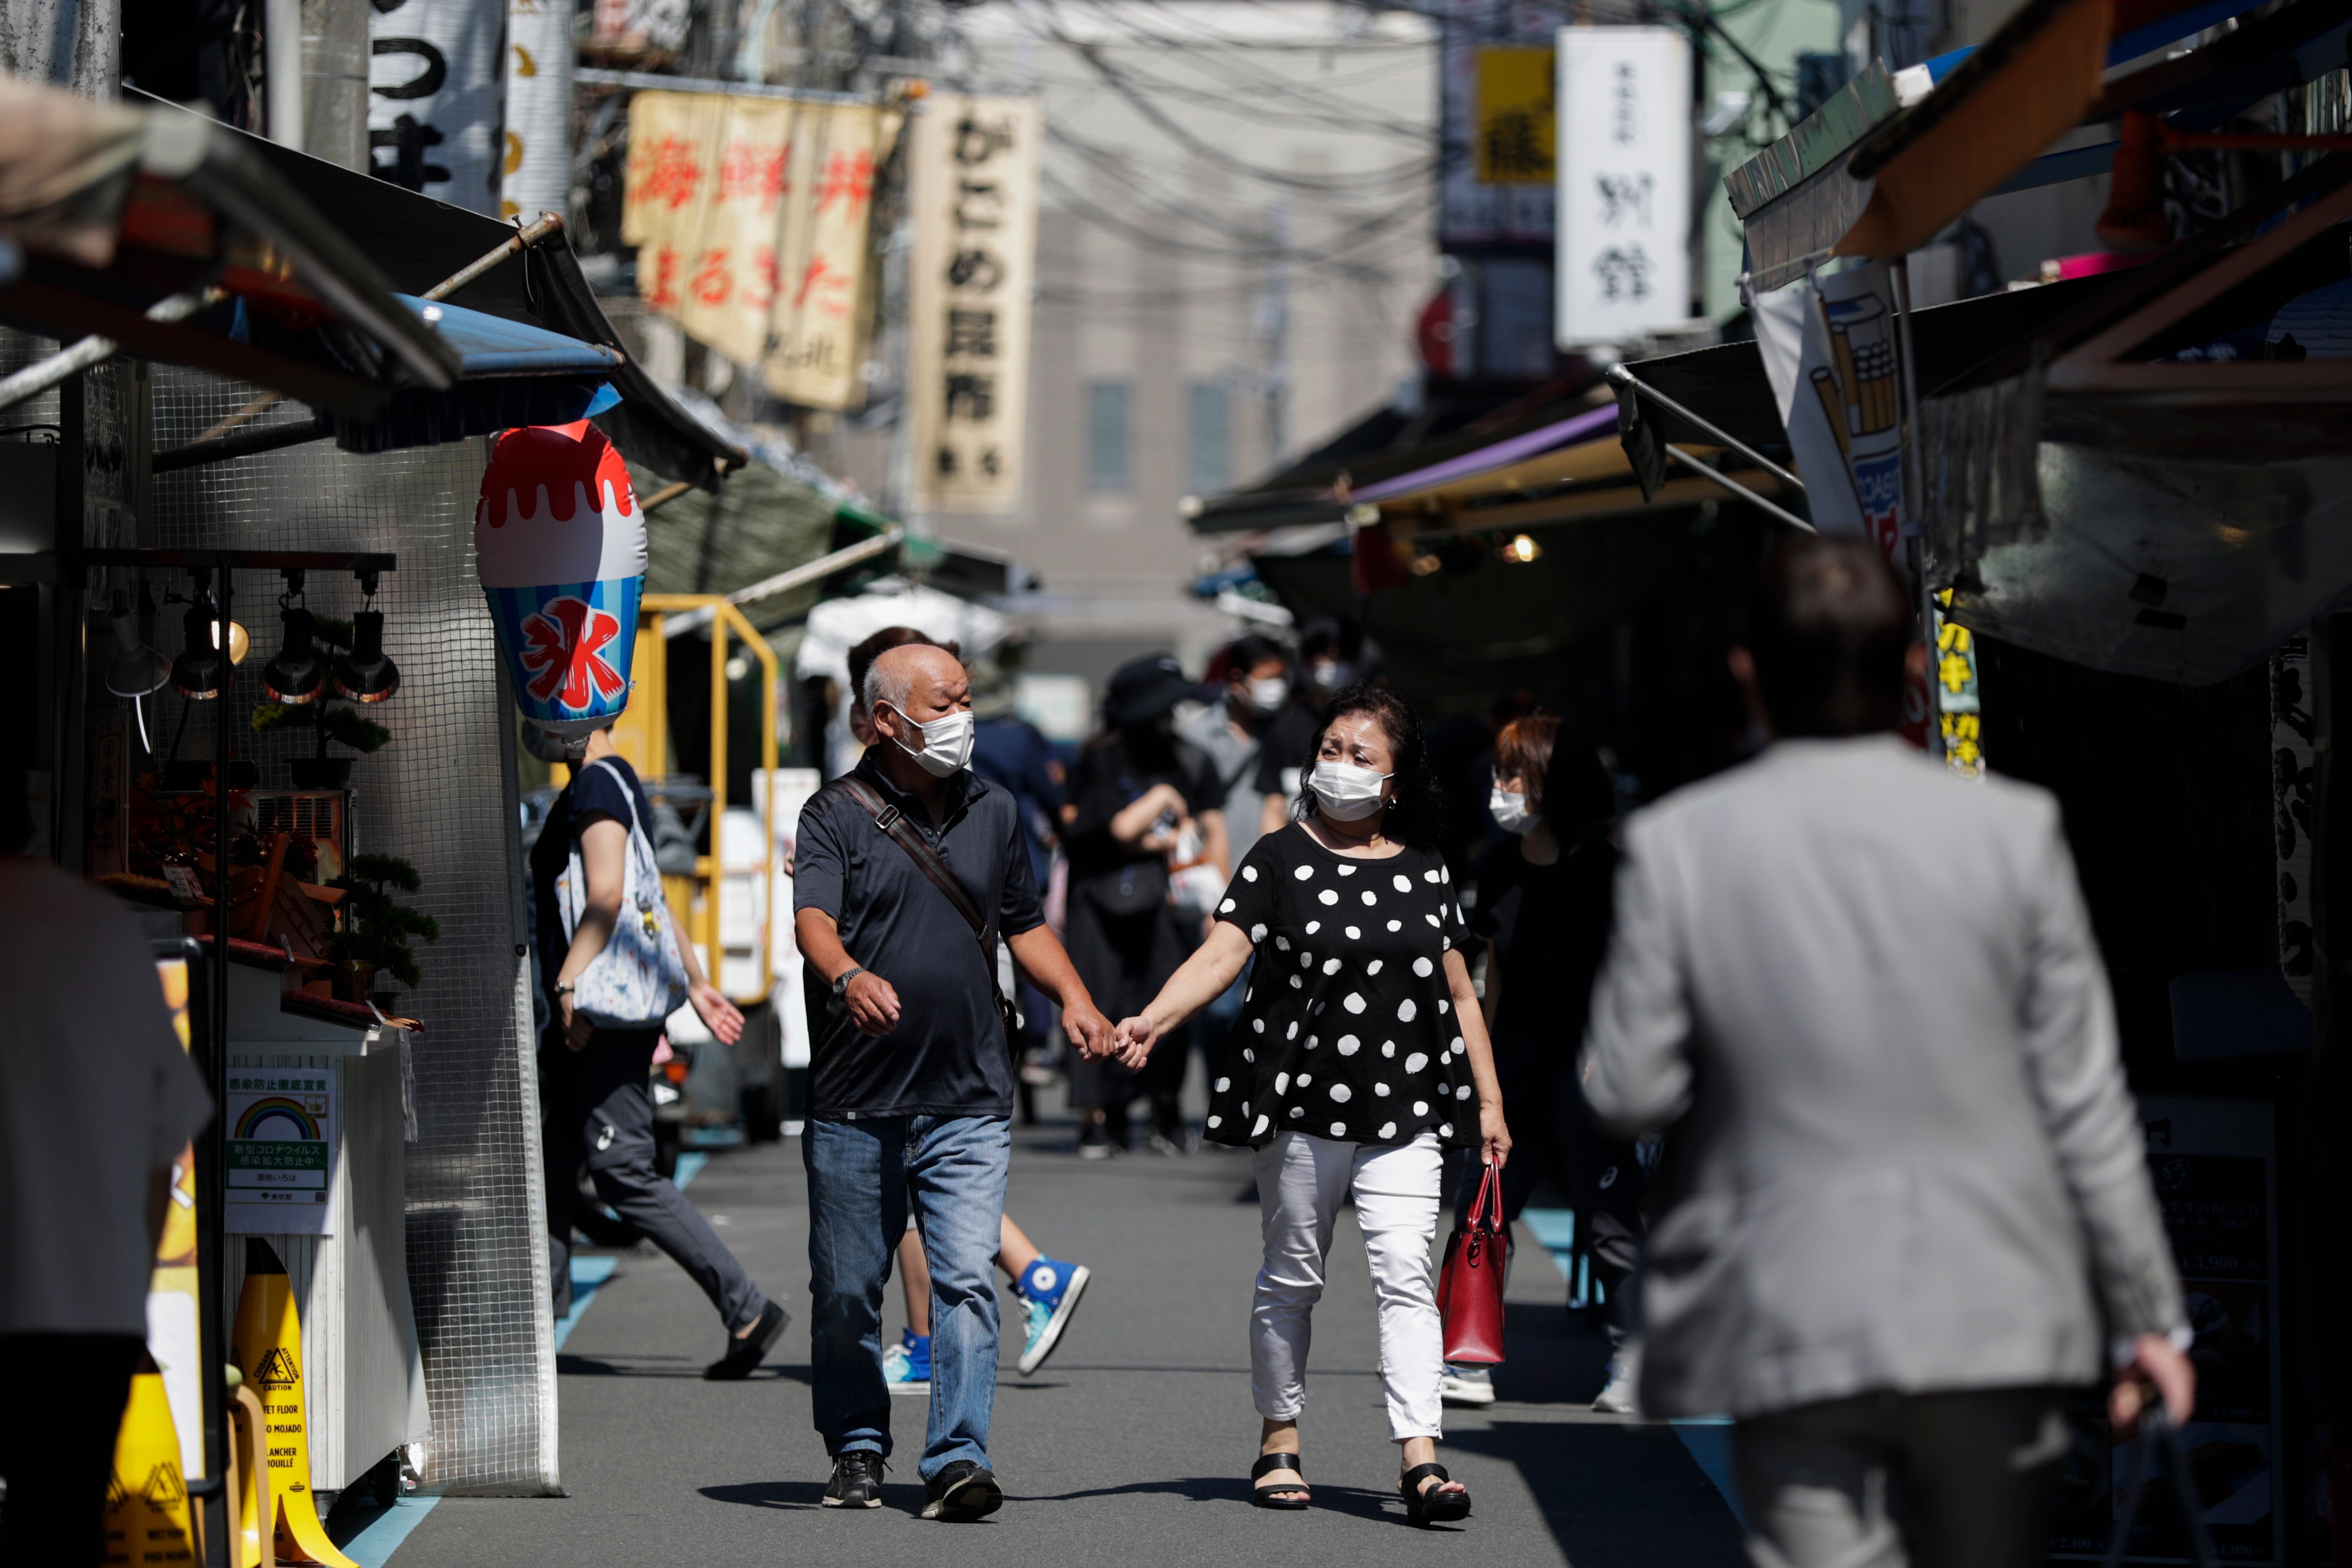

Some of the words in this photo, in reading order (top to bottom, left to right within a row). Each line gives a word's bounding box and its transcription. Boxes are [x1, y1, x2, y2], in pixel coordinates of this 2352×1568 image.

[646, 243, 852, 317] まるきた
[520, 596, 625, 710] 氷
[229, 1079, 327, 1091] 感染防止徹底宣言
[234, 1144, 319, 1155] 新型コロナウイルス
[240, 1156, 314, 1166] 感染拡大防止中
[257, 1173, 296, 1182] 築地いろは
[254, 1349, 272, 1378] CUIDADO
[281, 1347, 300, 1380] ATTENTION
[277, 1405, 298, 1414] FLOOR
[274, 1424, 301, 1433] MOJADO
[267, 1448, 297, 1456] ANCHER
